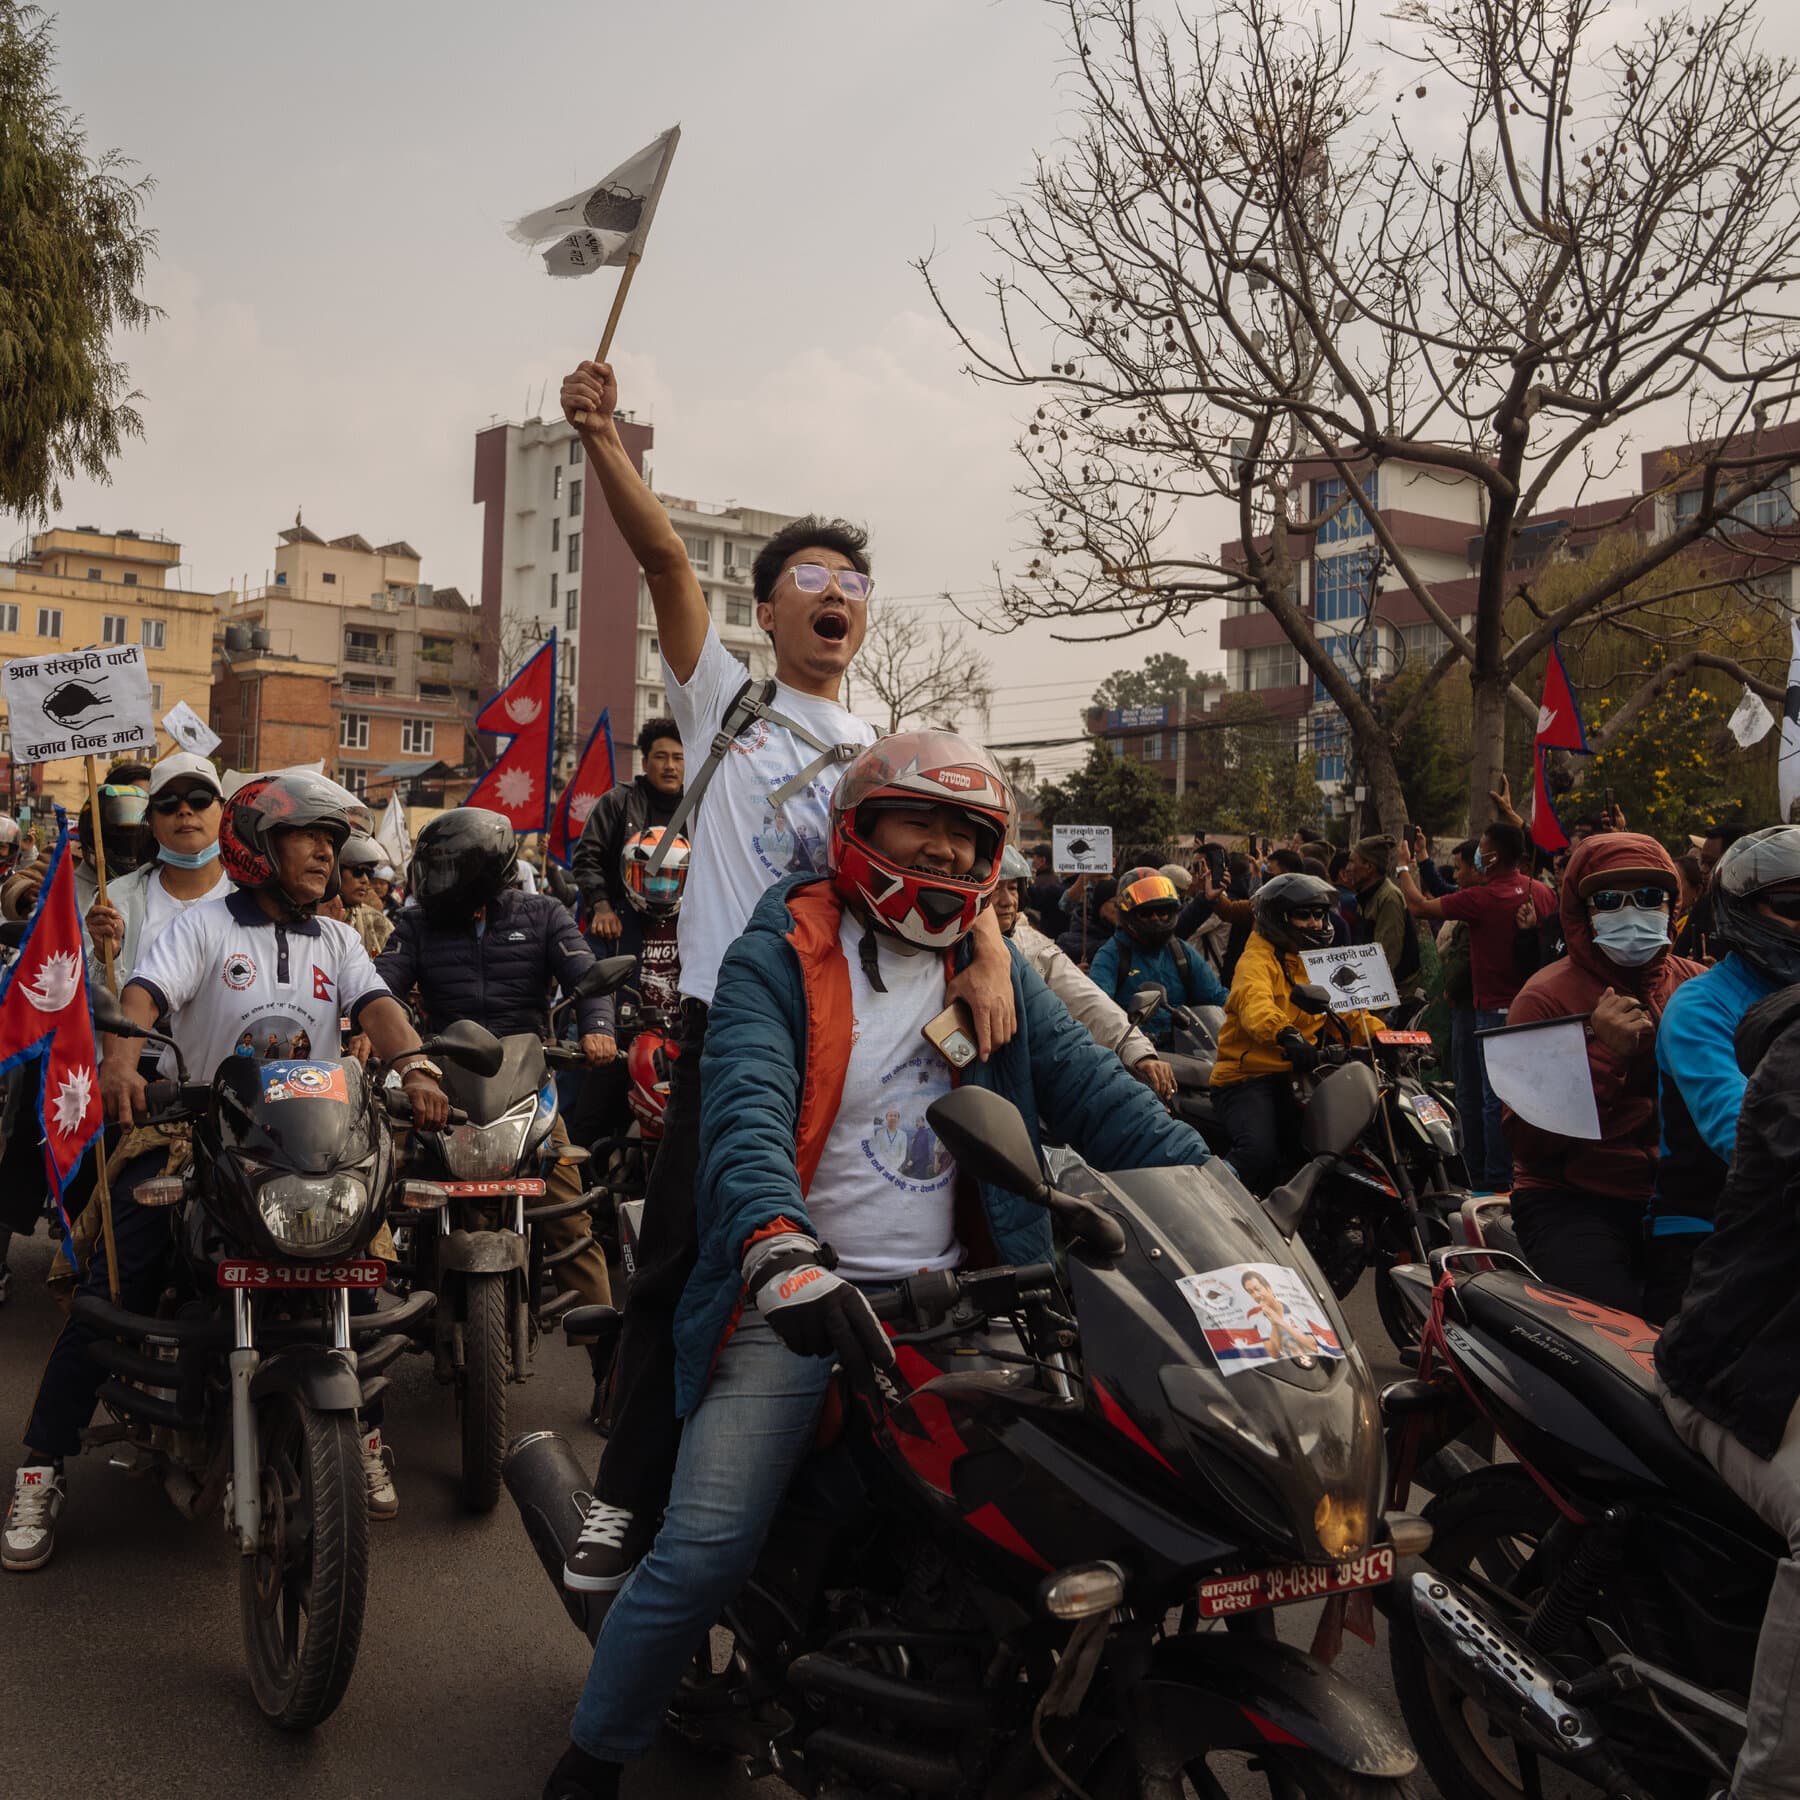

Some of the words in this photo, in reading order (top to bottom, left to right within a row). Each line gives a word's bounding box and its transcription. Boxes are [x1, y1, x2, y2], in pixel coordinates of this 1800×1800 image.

[9, 664, 39, 680] श्रम
[44, 653, 102, 675] संस्कृति
[106, 648, 139, 666] पार्टी
[26, 740, 67, 760] चुनाव
[71, 734, 108, 751] चिन्ह
[112, 725, 145, 744] माटो
[1326, 948, 1357, 963] संस्कृति
[779, 1269, 824, 1300] YANGO
[1211, 1593, 1253, 1613] प्रदेश
